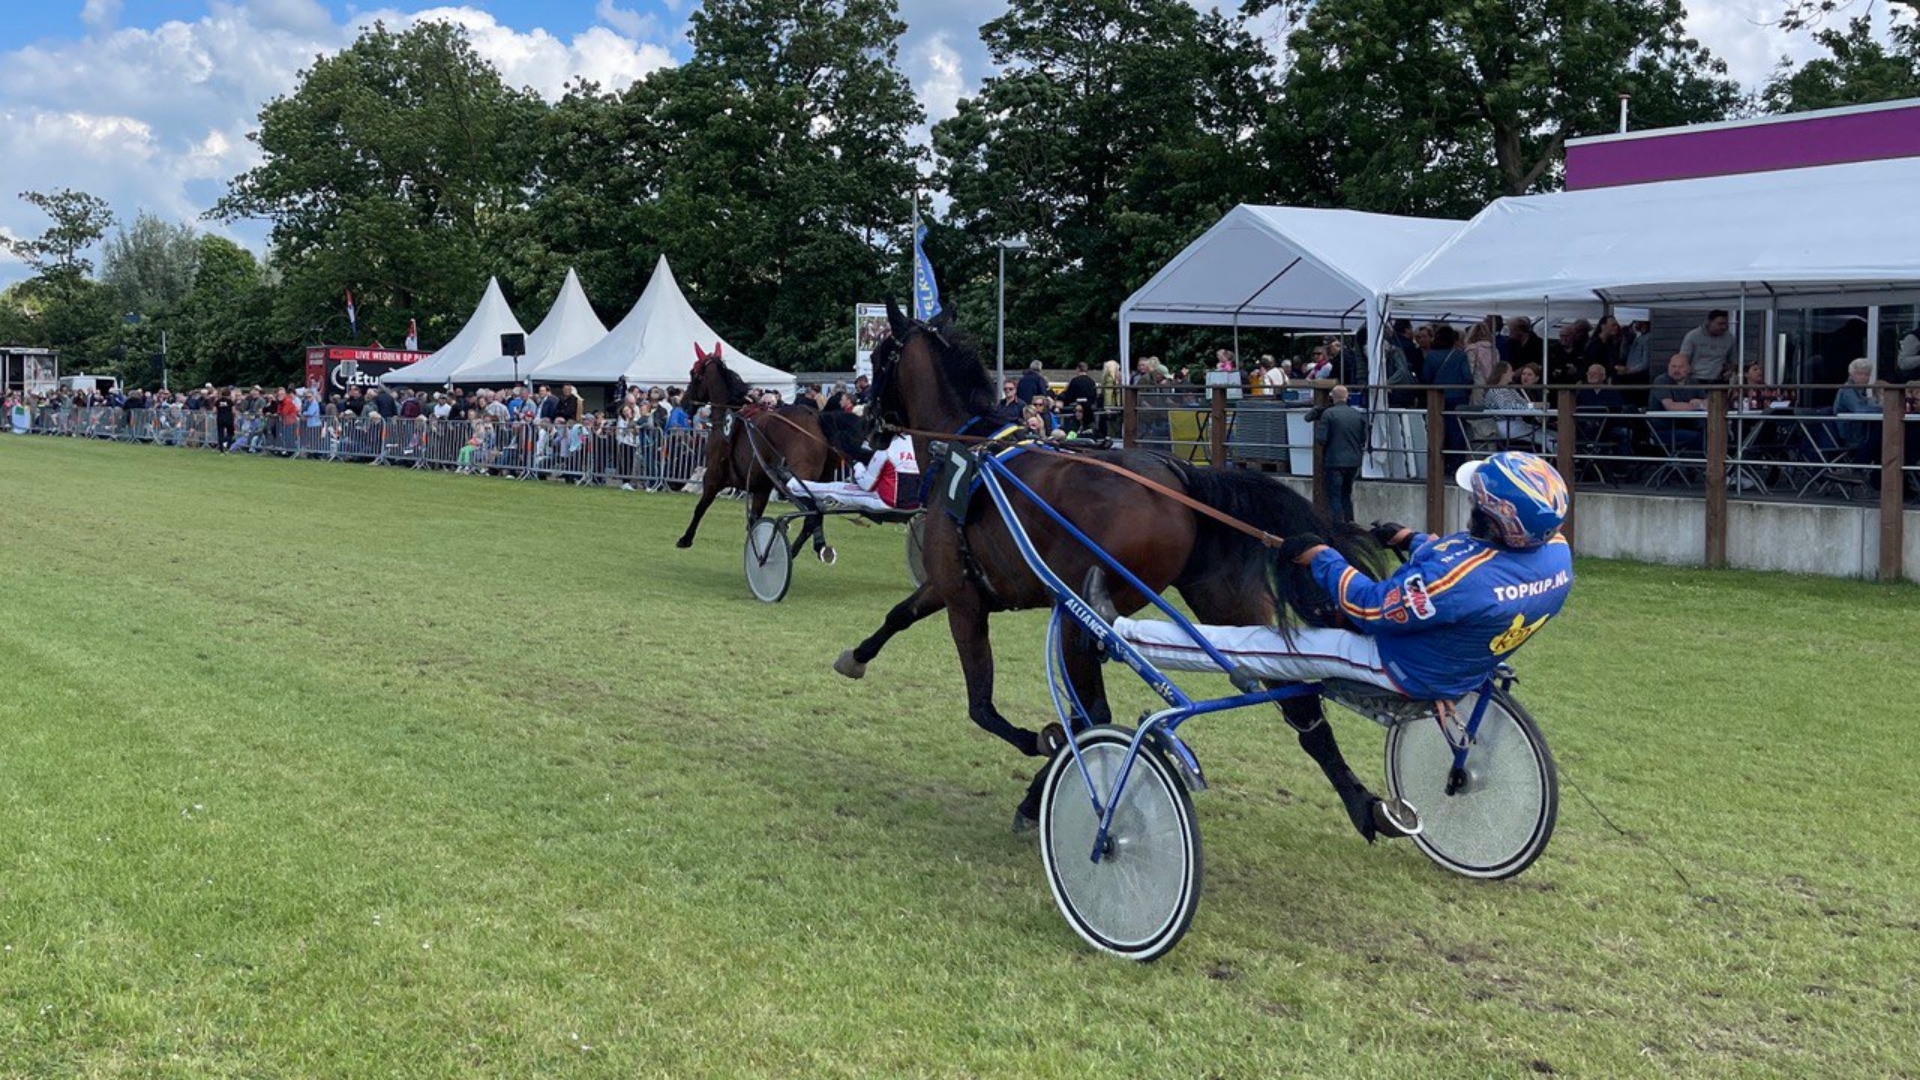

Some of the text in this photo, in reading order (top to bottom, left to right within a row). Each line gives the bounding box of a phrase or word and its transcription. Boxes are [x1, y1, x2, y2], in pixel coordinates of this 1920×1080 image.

[355, 350, 370, 360] LIVE
[372, 351, 401, 361] WEDDEN
[402, 352, 413, 362] OP
[723, 413, 733, 436] 3
[899, 451, 914, 461] FA
[948, 451, 967, 501] 7
[1493, 569, 1570, 602] TOPKIP.NL
[1064, 598, 1109, 640] ALLIANCE
